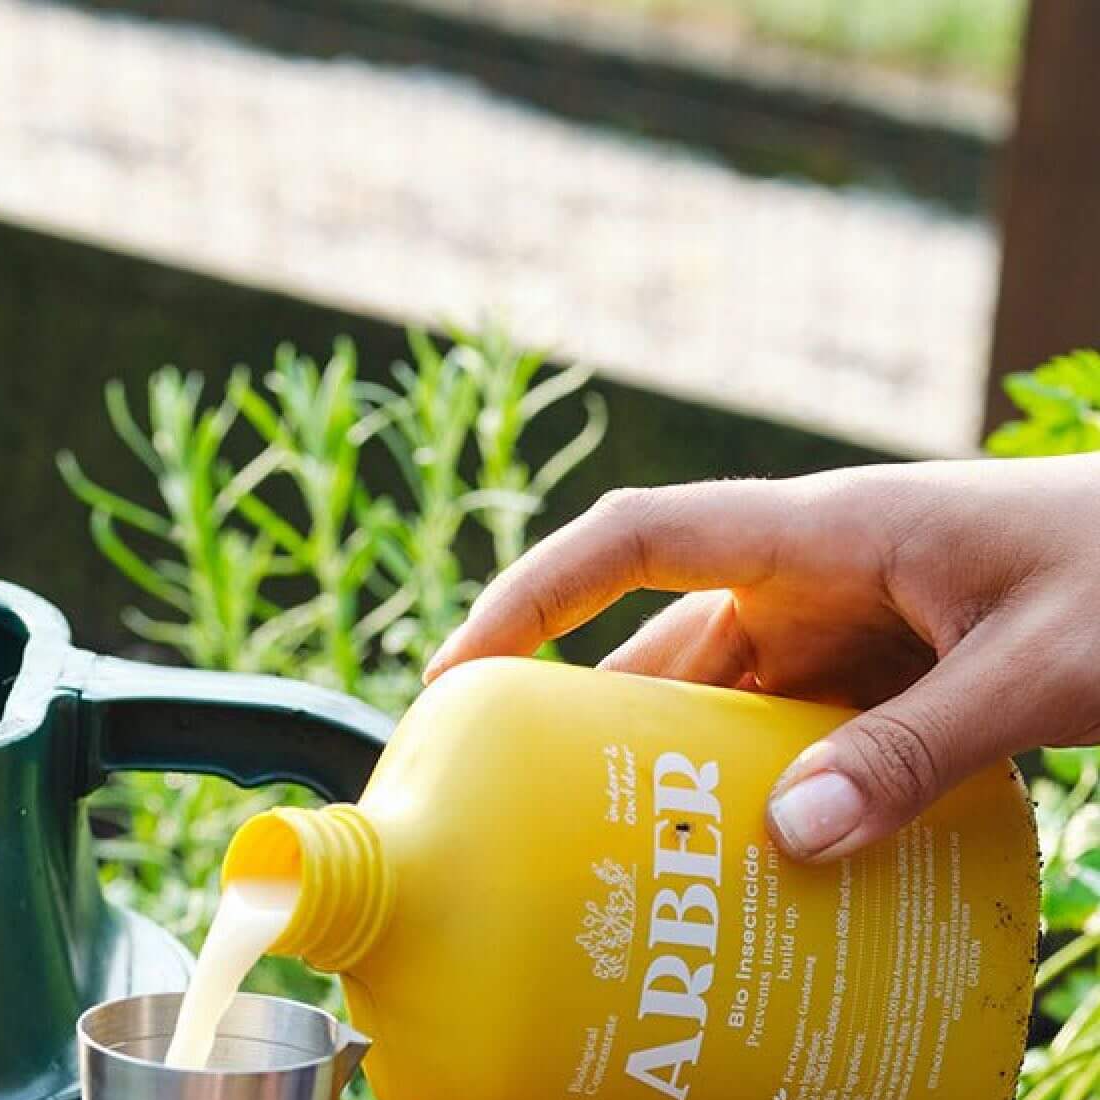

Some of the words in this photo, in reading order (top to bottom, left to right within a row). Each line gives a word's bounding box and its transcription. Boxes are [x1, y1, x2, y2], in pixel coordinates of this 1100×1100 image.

[736, 844, 759, 980] Insecticide
[764, 875, 779, 908] and
[784, 902, 798, 929] up.
[761, 913, 777, 965] insect
[776, 935, 795, 981] build
[727, 988, 749, 1028] Bio
[746, 971, 772, 1047] Prevents
